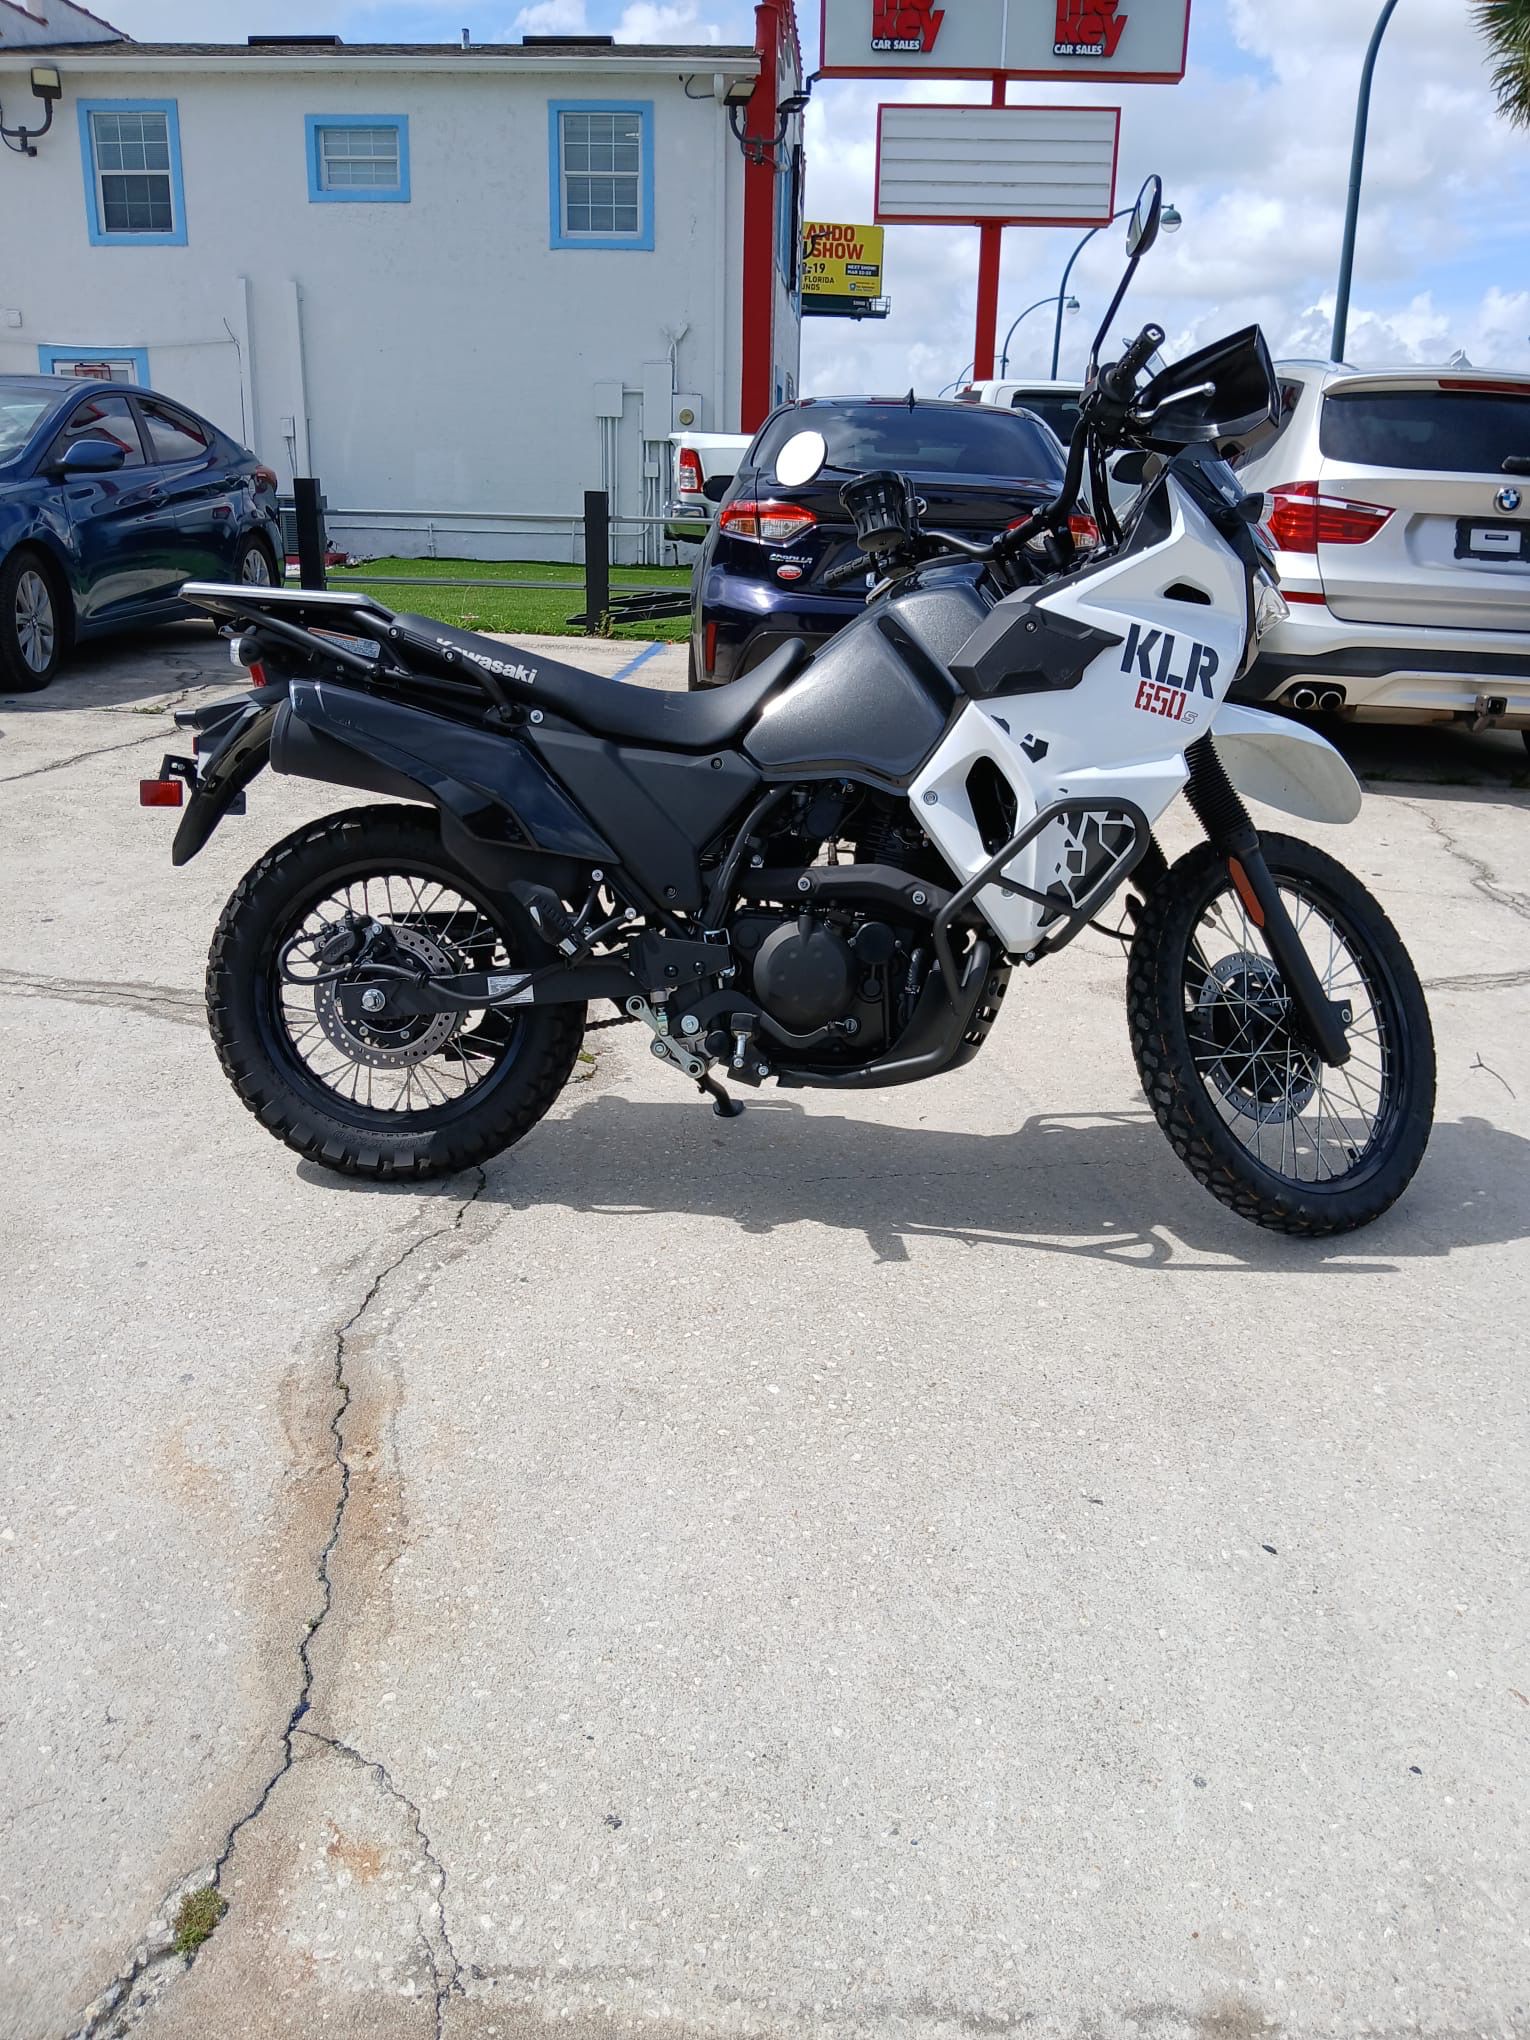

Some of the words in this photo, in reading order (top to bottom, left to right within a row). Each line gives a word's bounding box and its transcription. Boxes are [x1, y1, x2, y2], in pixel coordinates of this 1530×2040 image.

[872, 40, 891, 49] CAR
[893, 40, 920, 50] SALES
[1054, 44, 1074, 54] CAR
[1075, 44, 1103, 55] SALES
[803, 224, 856, 243] ANDO
[812, 242, 864, 260] SHOW
[804, 275, 835, 284] FLORIDA
[1120, 623, 1219, 700] KLR
